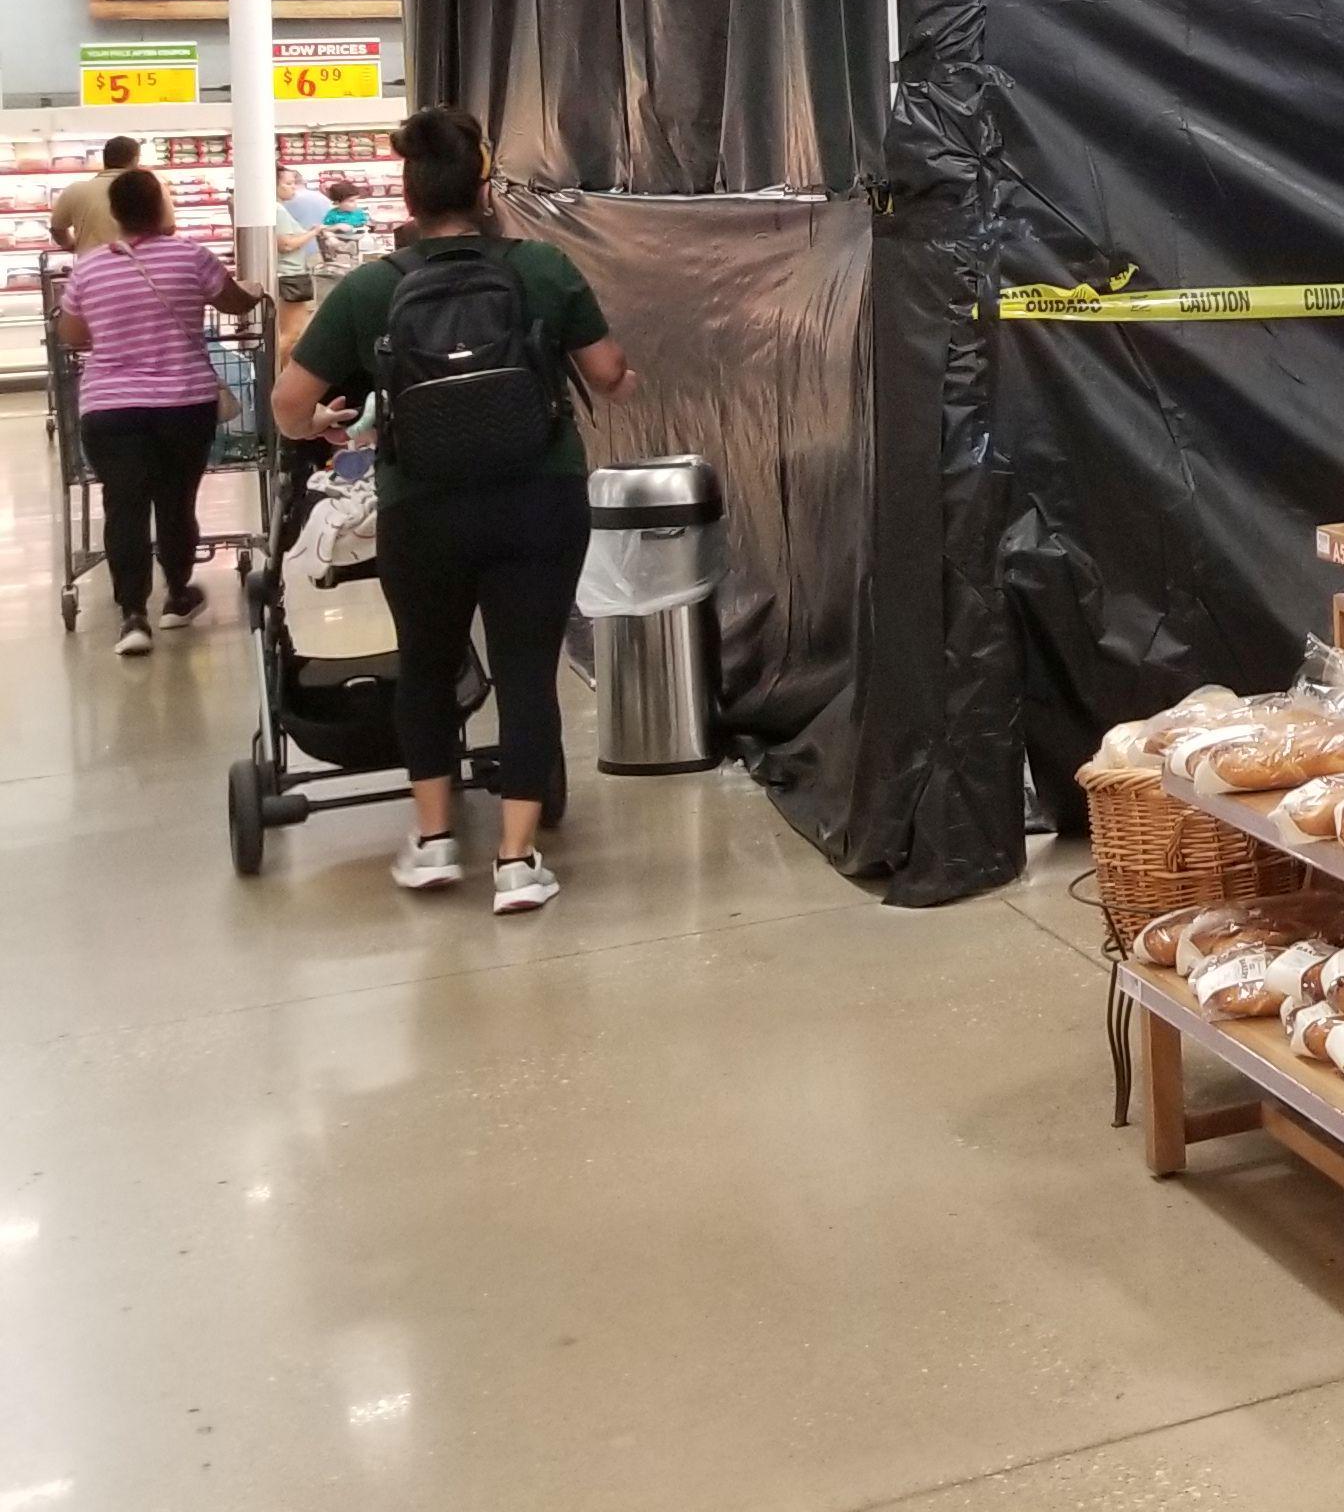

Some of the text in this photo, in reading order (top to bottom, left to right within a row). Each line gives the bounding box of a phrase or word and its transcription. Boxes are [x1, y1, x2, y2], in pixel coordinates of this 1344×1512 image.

[281, 43, 368, 56] LOW PRICES
[1179, 289, 1250, 313] CAUTION
